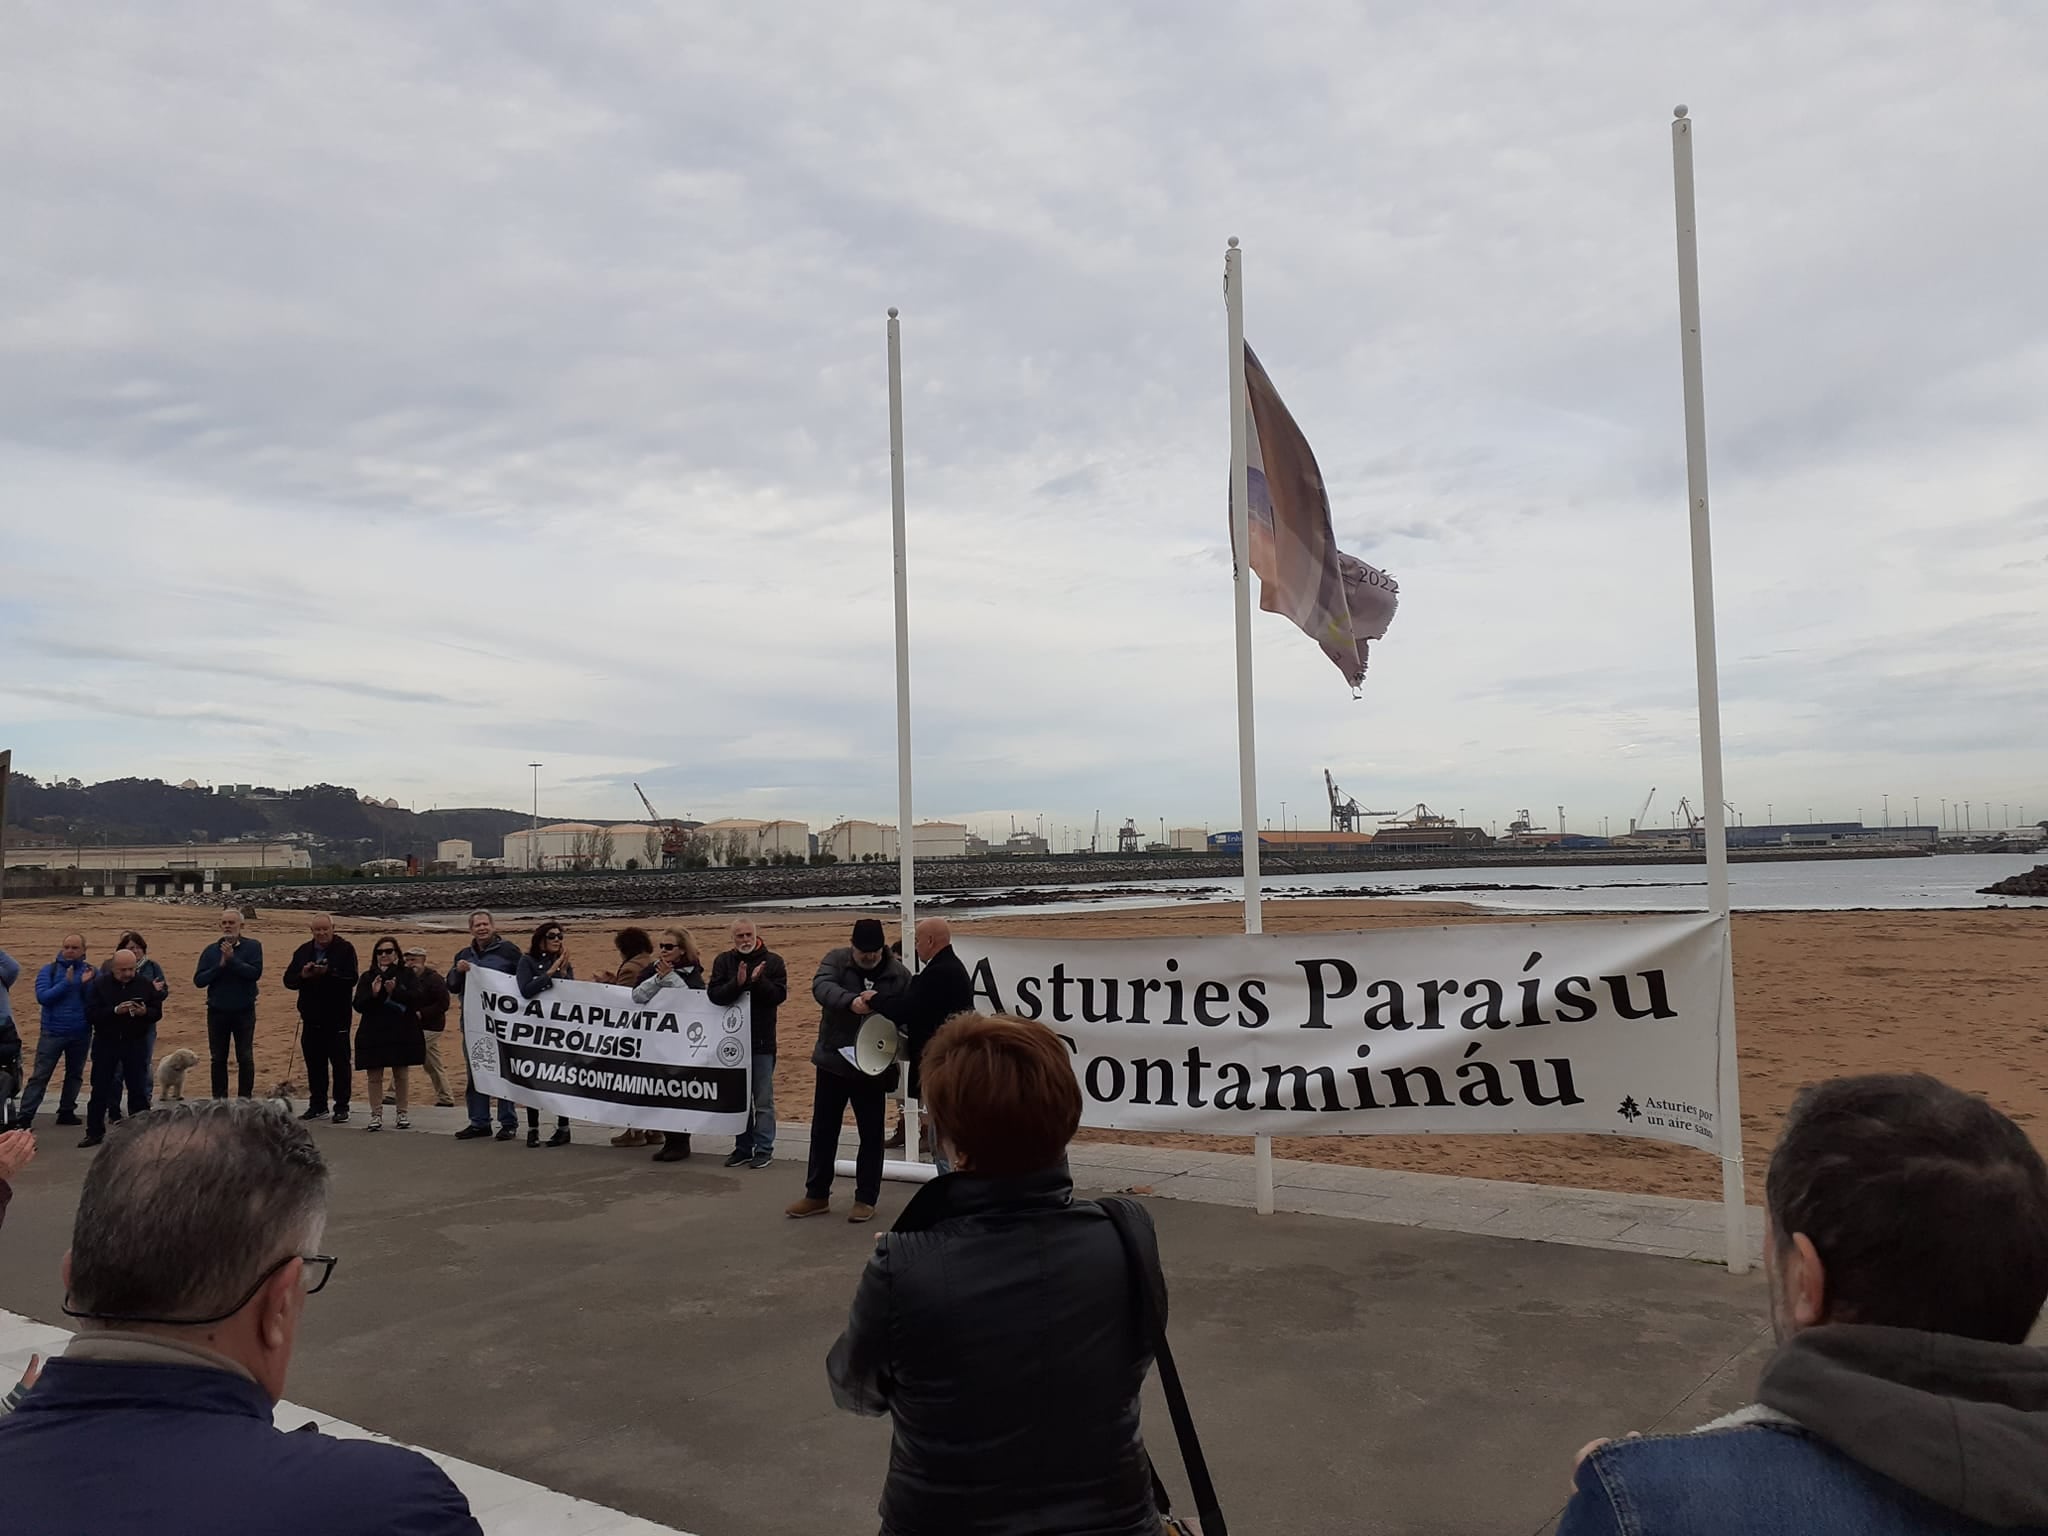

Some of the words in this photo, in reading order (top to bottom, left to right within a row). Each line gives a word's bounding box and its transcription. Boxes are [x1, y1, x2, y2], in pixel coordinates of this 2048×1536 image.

[1359, 566, 1400, 594] 2022
[970, 955, 1270, 1029] Asturies
[1295, 951, 1678, 1031] Paraísu
[523, 999, 545, 1019] A
[550, 1002, 584, 1024] LA
[588, 1006, 680, 1033] PLANTA
[485, 1014, 508, 1040] DE
[511, 1022, 643, 1059] PIRÓLISIS!
[510, 1057, 536, 1078] NO
[536, 1061, 578, 1085] MÁS
[578, 1069, 718, 1101] CONTAMINACIÓN
[1058, 1034, 1586, 1113] ontamináu
[1645, 1097, 1697, 1115] Asturies
[1699, 1108, 1713, 1121] por
[1647, 1116, 1665, 1126] un
[1668, 1117, 1692, 1131] aire
